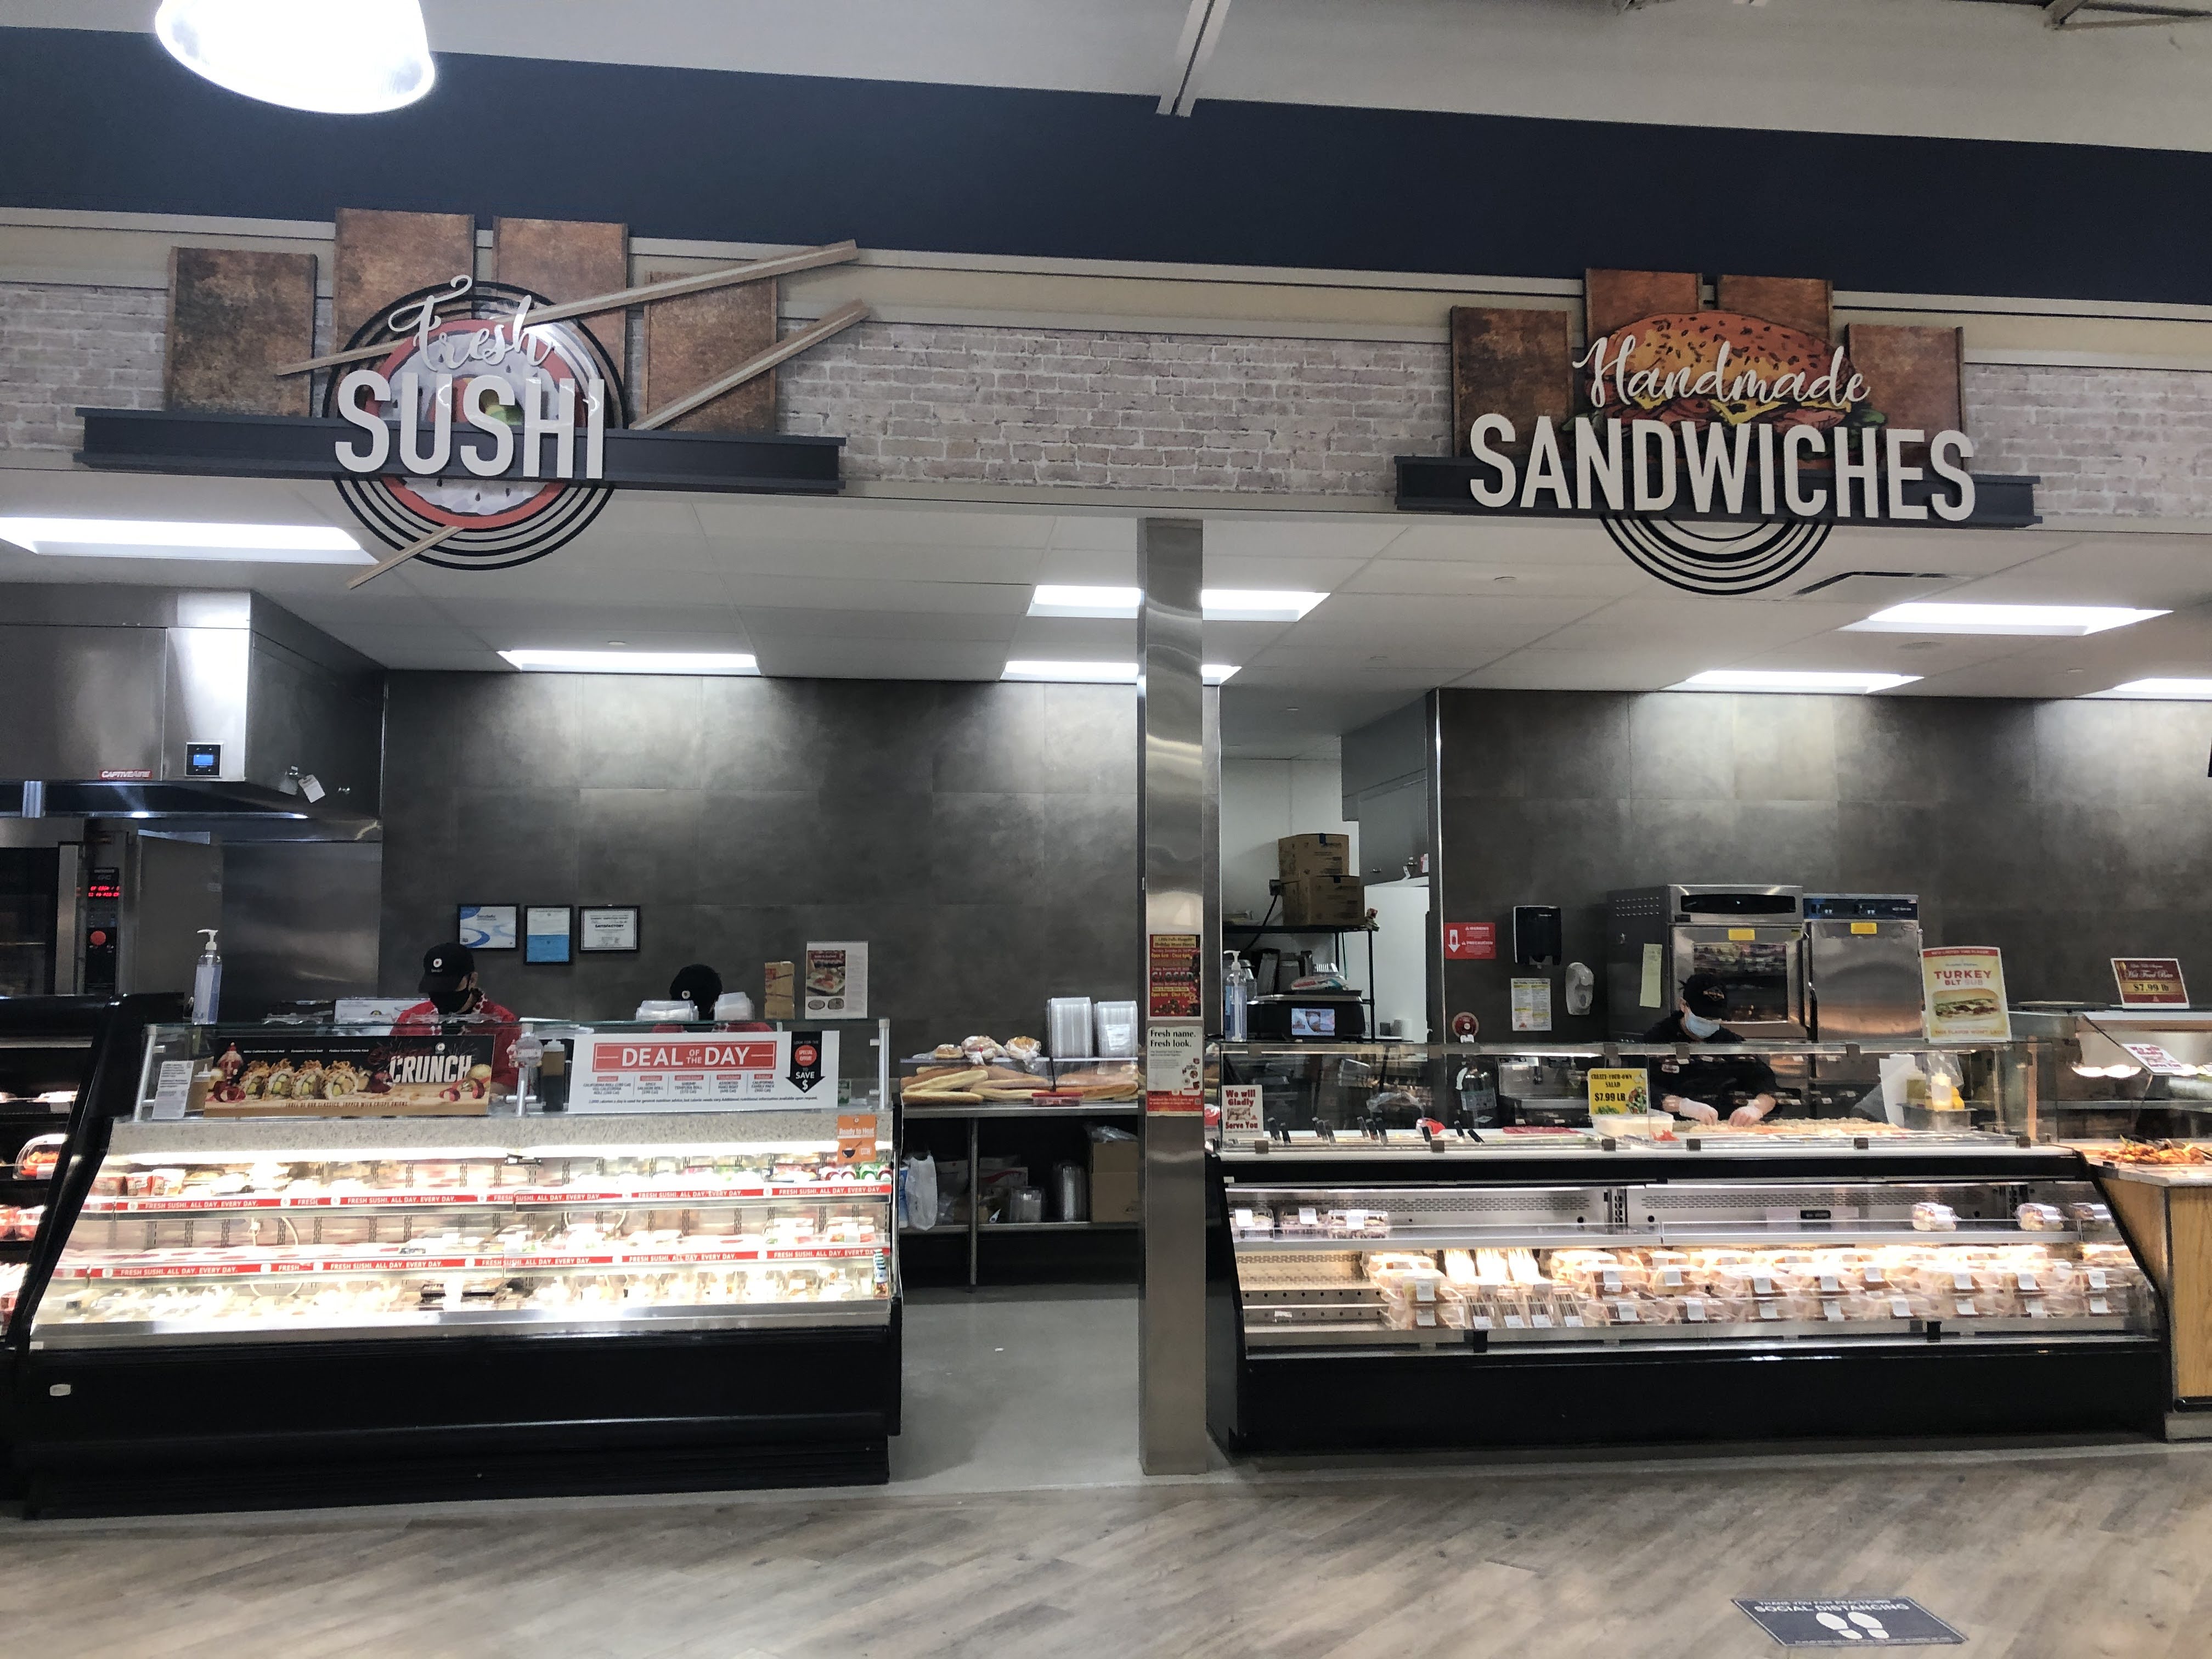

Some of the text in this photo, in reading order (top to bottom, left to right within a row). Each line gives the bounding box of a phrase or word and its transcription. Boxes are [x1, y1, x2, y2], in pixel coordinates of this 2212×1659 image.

[388, 274, 553, 371] Fresh
[1572, 336, 1871, 408] Handmade
[335, 369, 604, 479] SUSHI
[1469, 413, 1975, 522] SANDWICHES
[1934, 970, 1991, 979] TURKEY
[1150, 1029, 1170, 1037] Fresh
[1173, 1039, 1192, 1047] look.
[622, 1047, 684, 1066] DEAL
[704, 1046, 750, 1065] DAY
[389, 1055, 472, 1083] CRUNCH
[795, 1071, 815, 1079] SAVE
[802, 1079, 808, 1091] $
[1241, 1089, 1256, 1097] will
[1594, 1092, 1626, 1102] $7.99 LB
[1228, 1098, 1254, 1107] Gladly
[839, 1127, 855, 1136] Ready
[1814, 1603, 1910, 1611] DISTANCING
